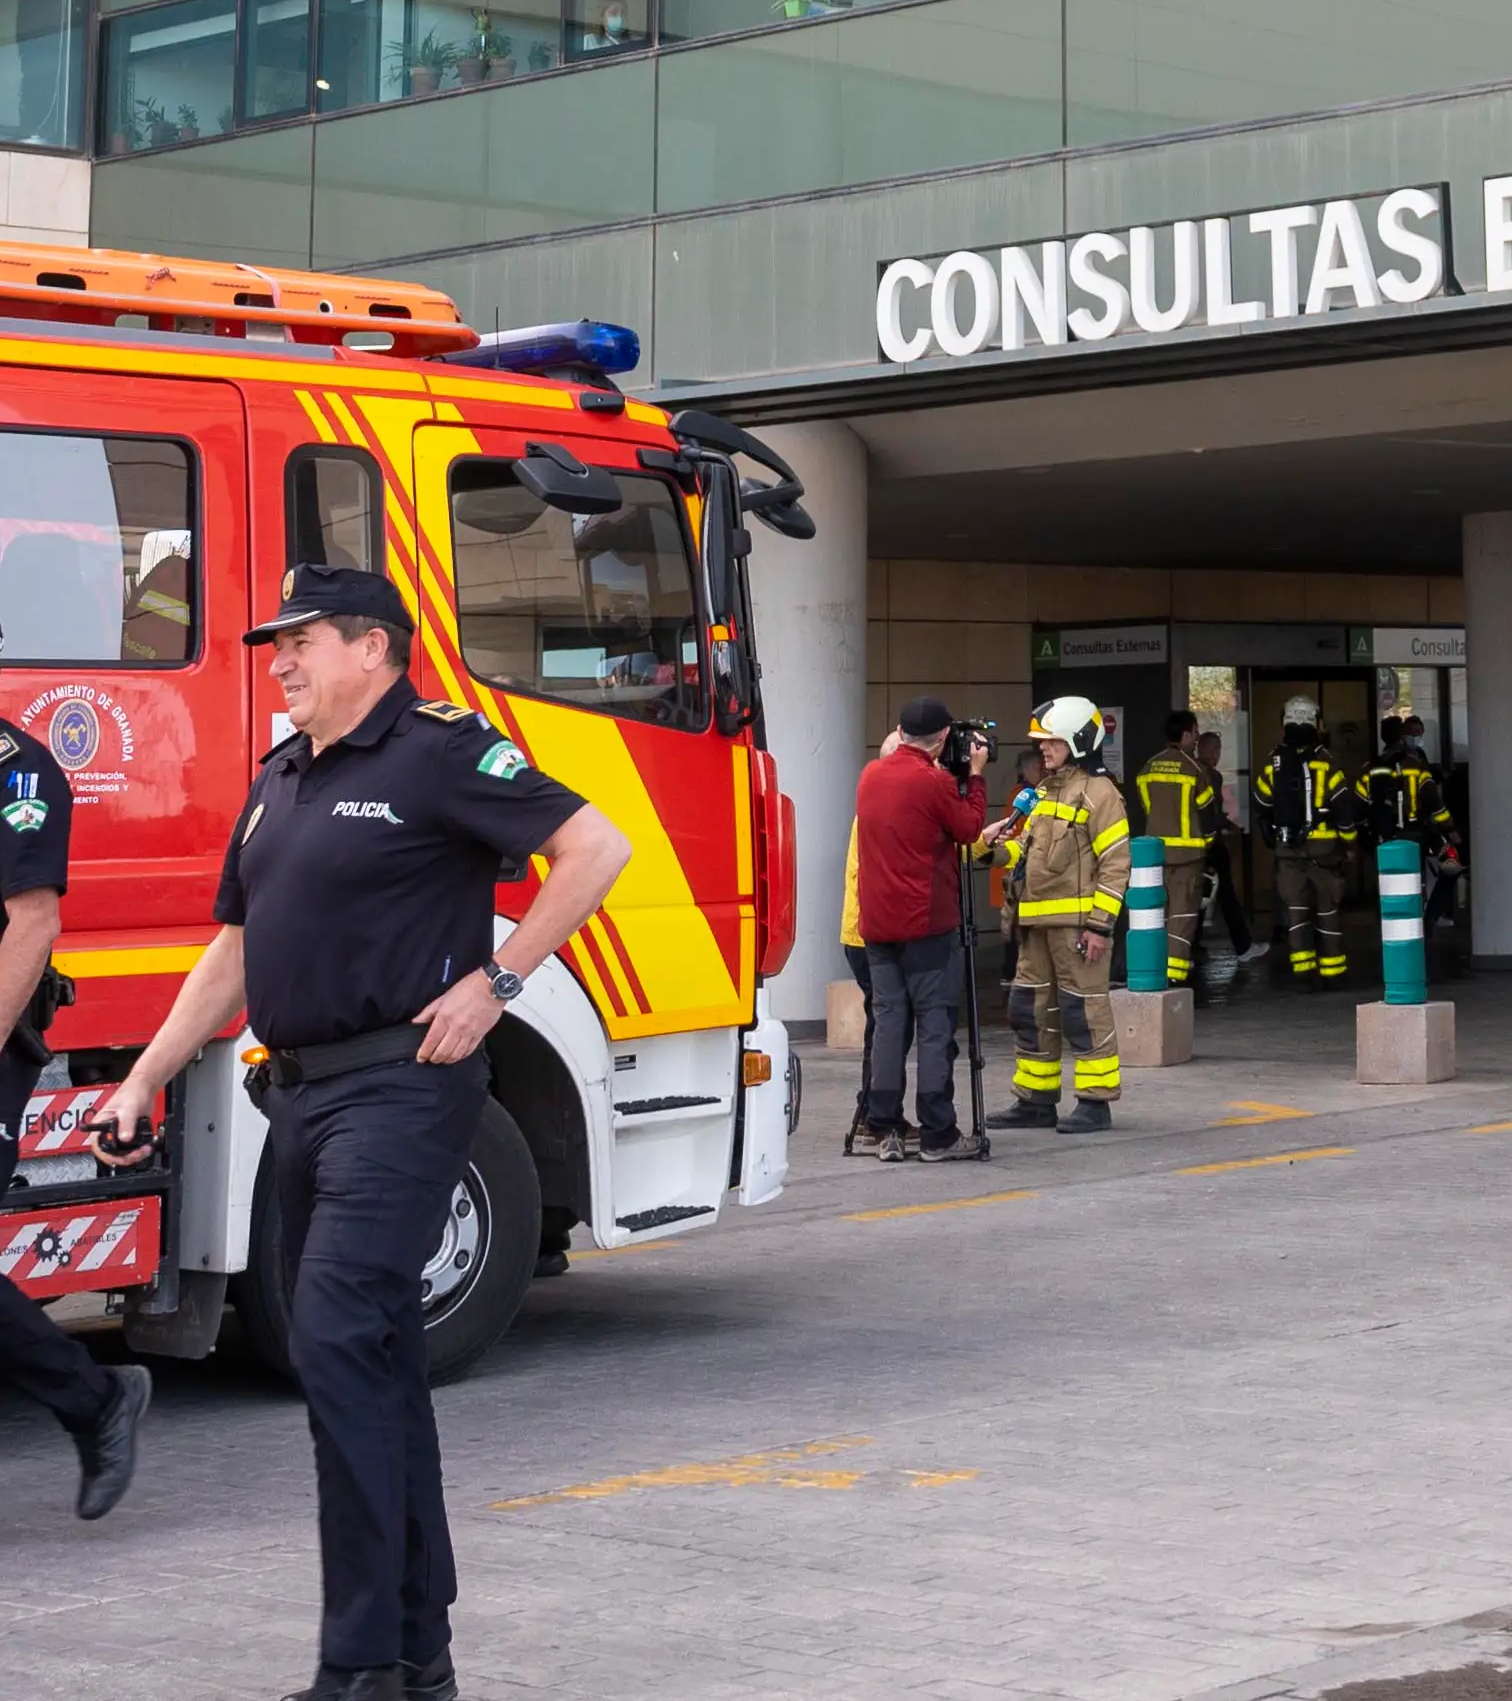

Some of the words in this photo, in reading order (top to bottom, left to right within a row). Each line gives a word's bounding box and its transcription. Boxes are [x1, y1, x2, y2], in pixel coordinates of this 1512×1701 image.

[876, 187, 1445, 363] CONSULTAS
[1063, 640, 1114, 655] Consultas
[1116, 638, 1161, 653] Externas
[1411, 637, 1466, 657] Consulta
[21, 684, 95, 727] AYUNTAMIENTO
[97, 692, 113, 710] DE
[111, 706, 135, 762] GRANADA
[332, 801, 392, 819] POLICIA
[25, 1102, 98, 1135] ENCIÓ
